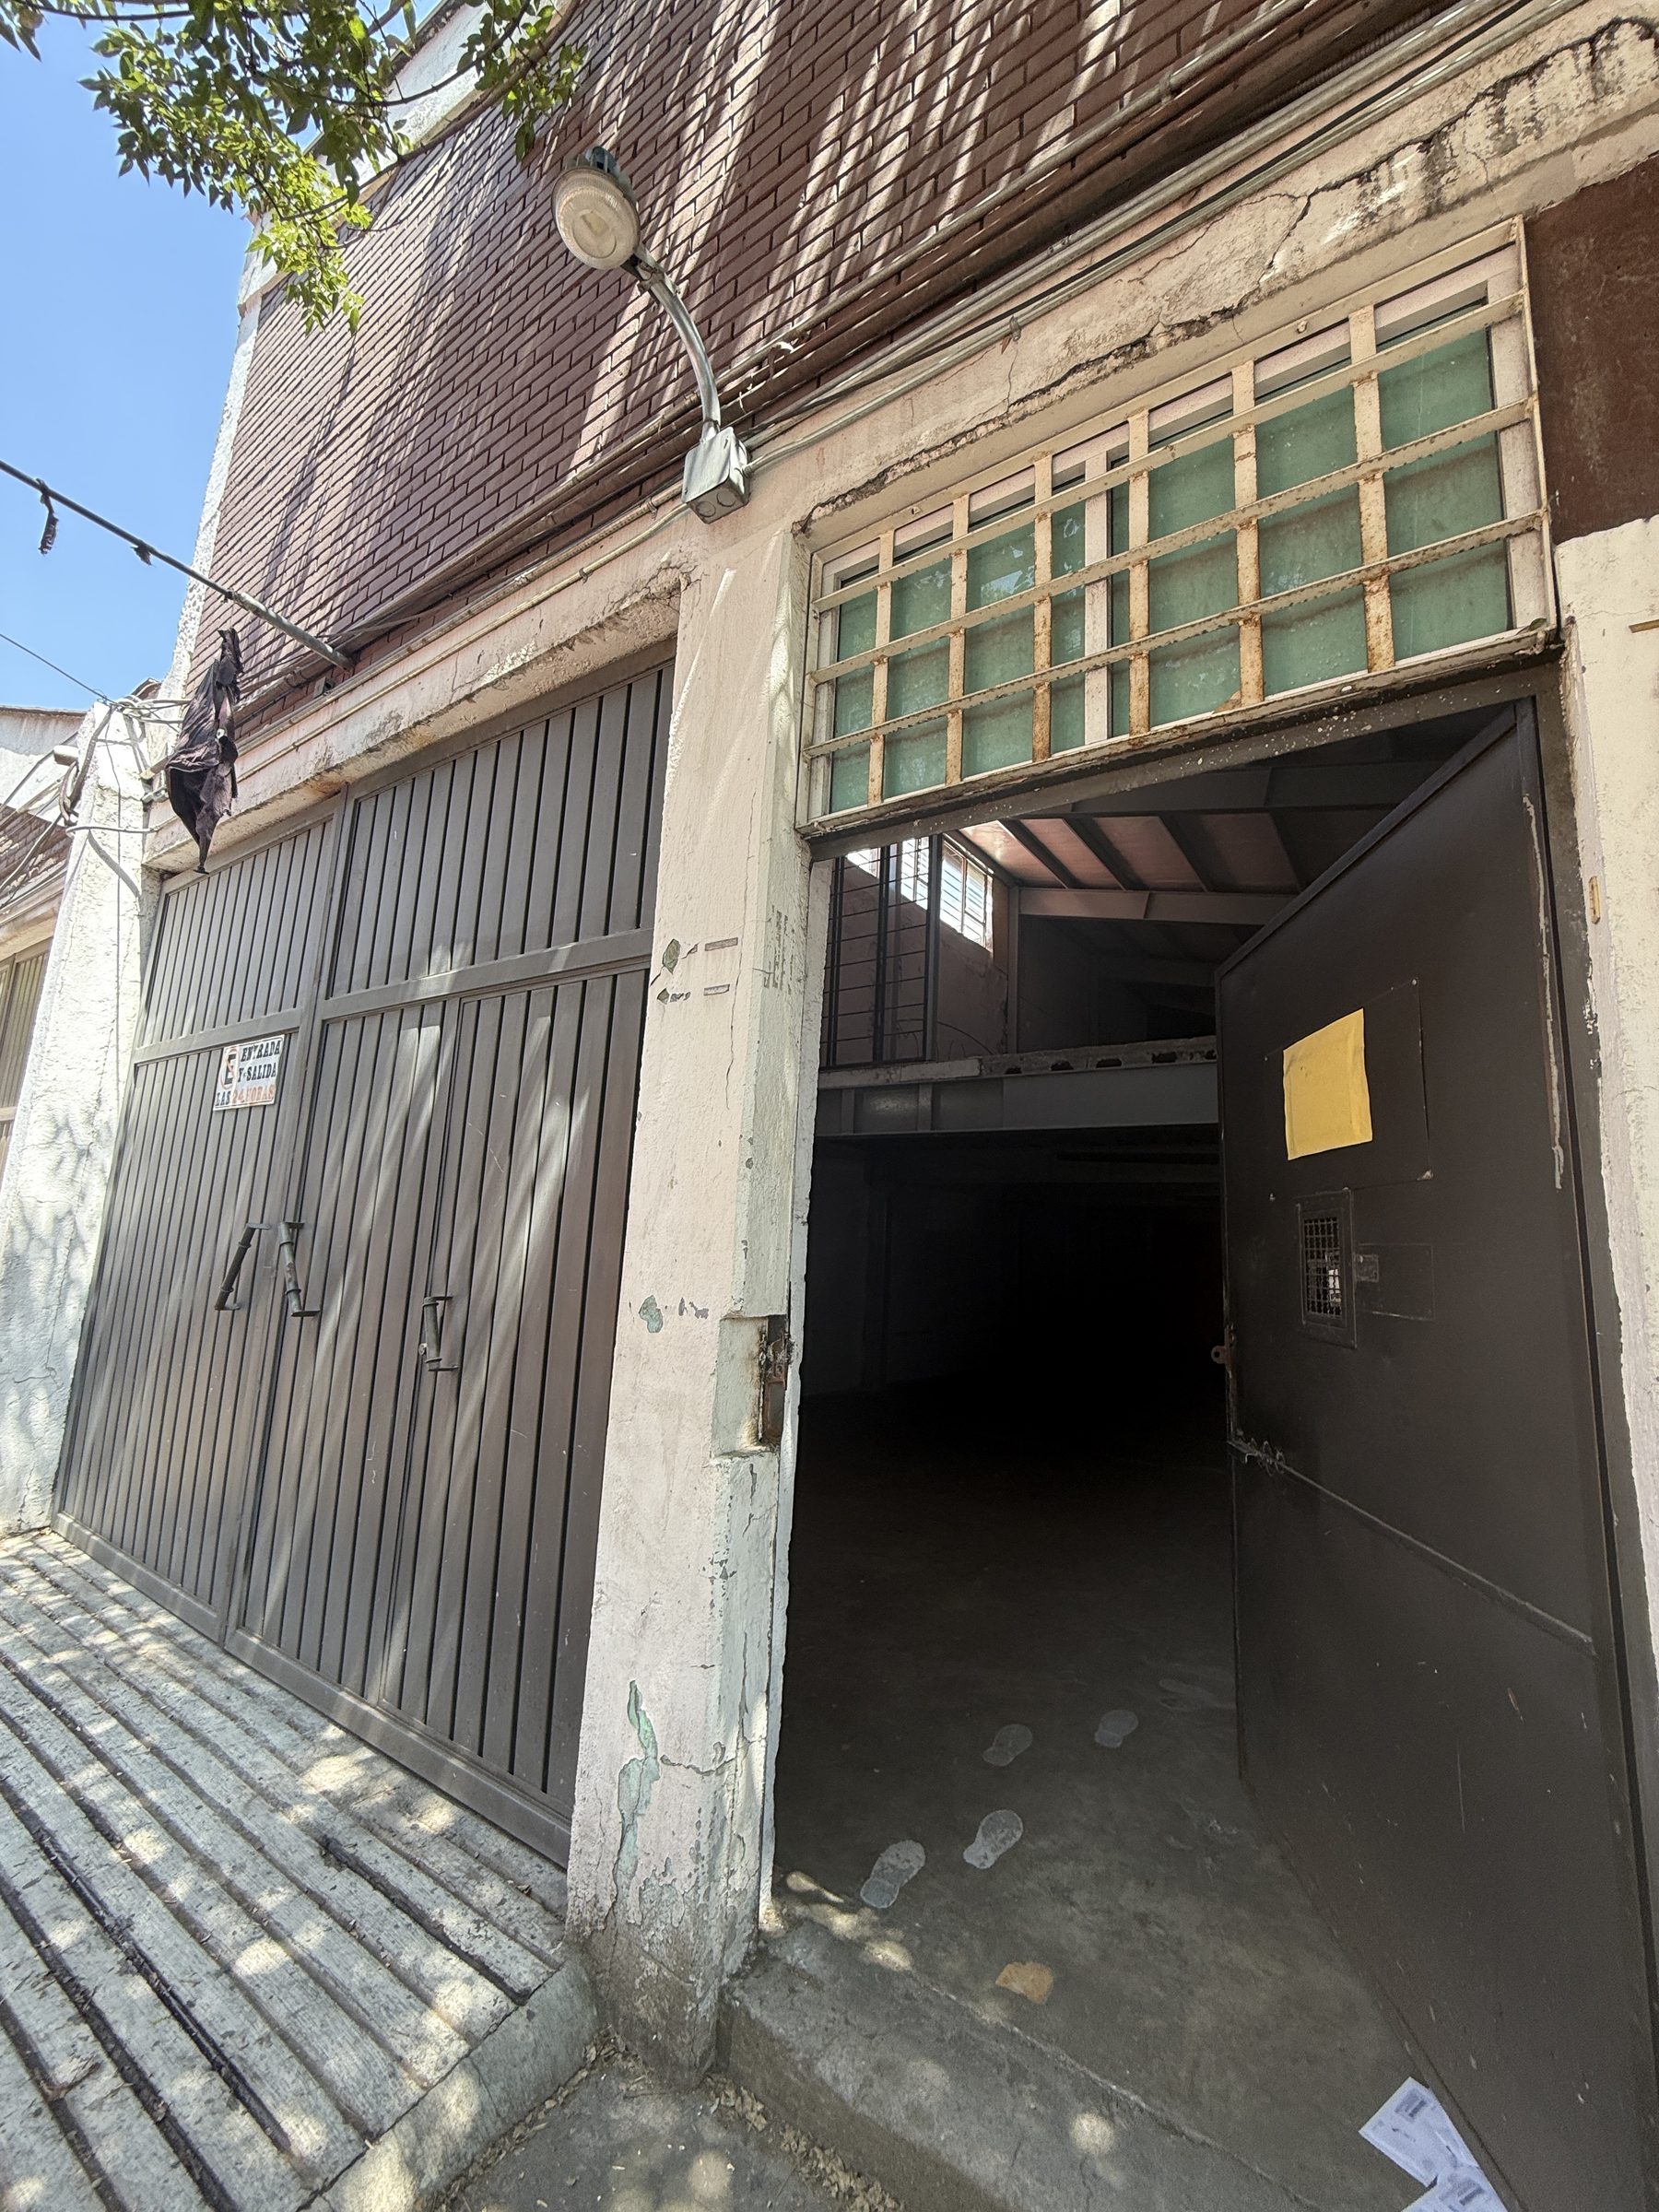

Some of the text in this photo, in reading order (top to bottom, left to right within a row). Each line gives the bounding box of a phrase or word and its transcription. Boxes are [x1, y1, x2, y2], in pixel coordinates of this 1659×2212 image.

[241, 1041, 281, 1062] ENTRADA
[238, 1063, 276, 1082] Y SALIDA
[216, 1091, 230, 1106] LAS
